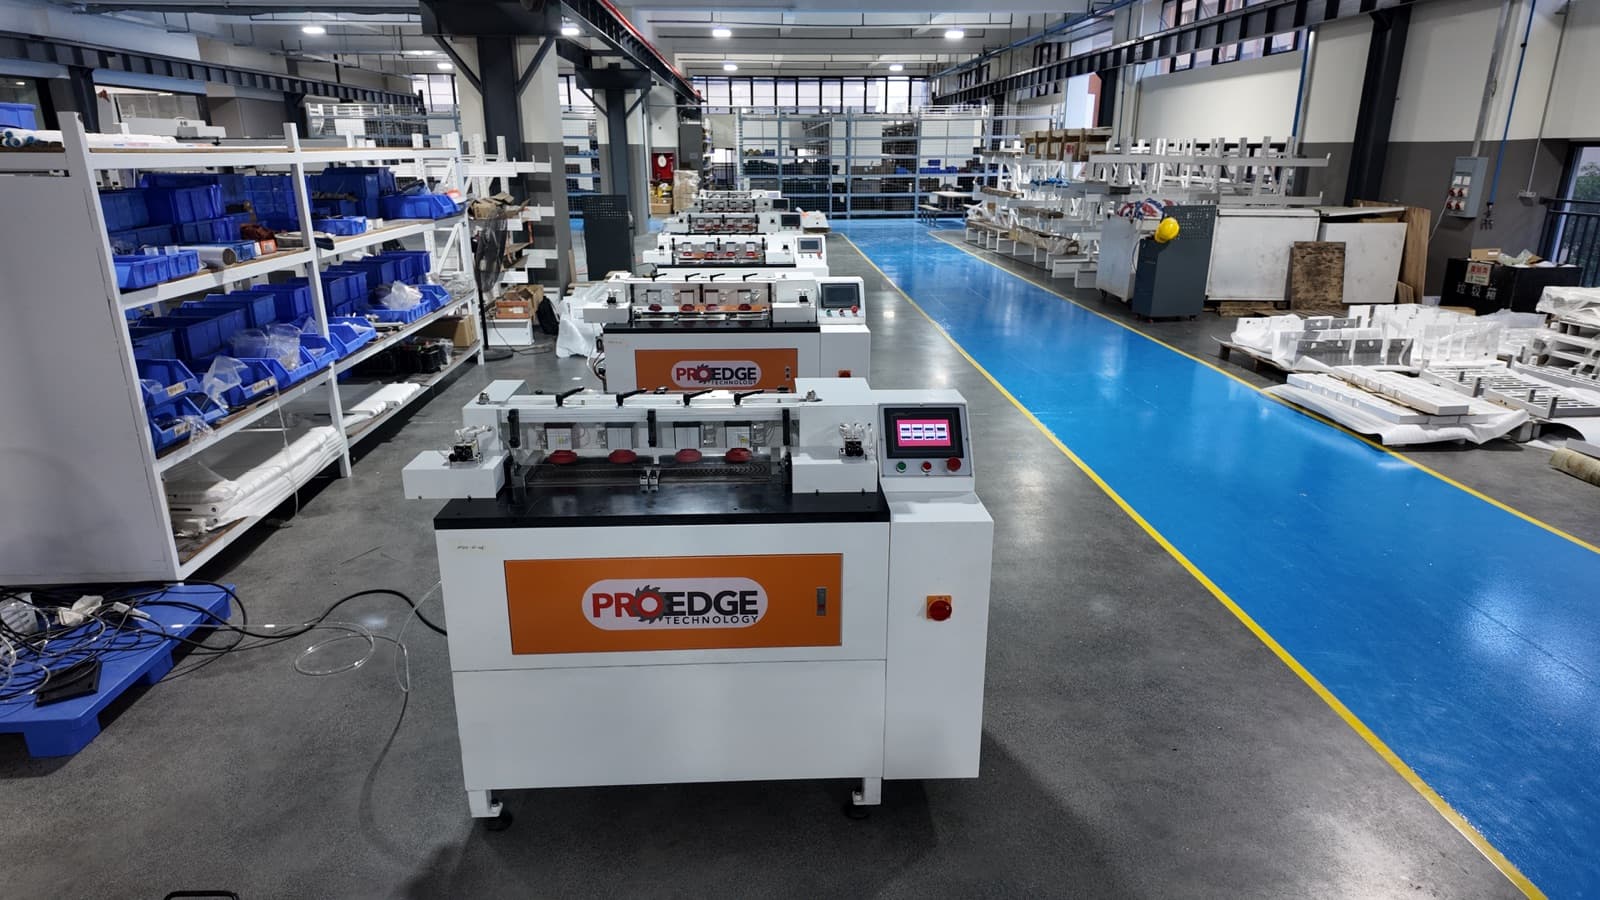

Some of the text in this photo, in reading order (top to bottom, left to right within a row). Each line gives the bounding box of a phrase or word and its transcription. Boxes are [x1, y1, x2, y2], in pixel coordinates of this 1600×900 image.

[676, 367, 757, 381] PROEDGE
[592, 590, 759, 618] PROEDGE
[665, 615, 758, 625] TECHNOLOGY
